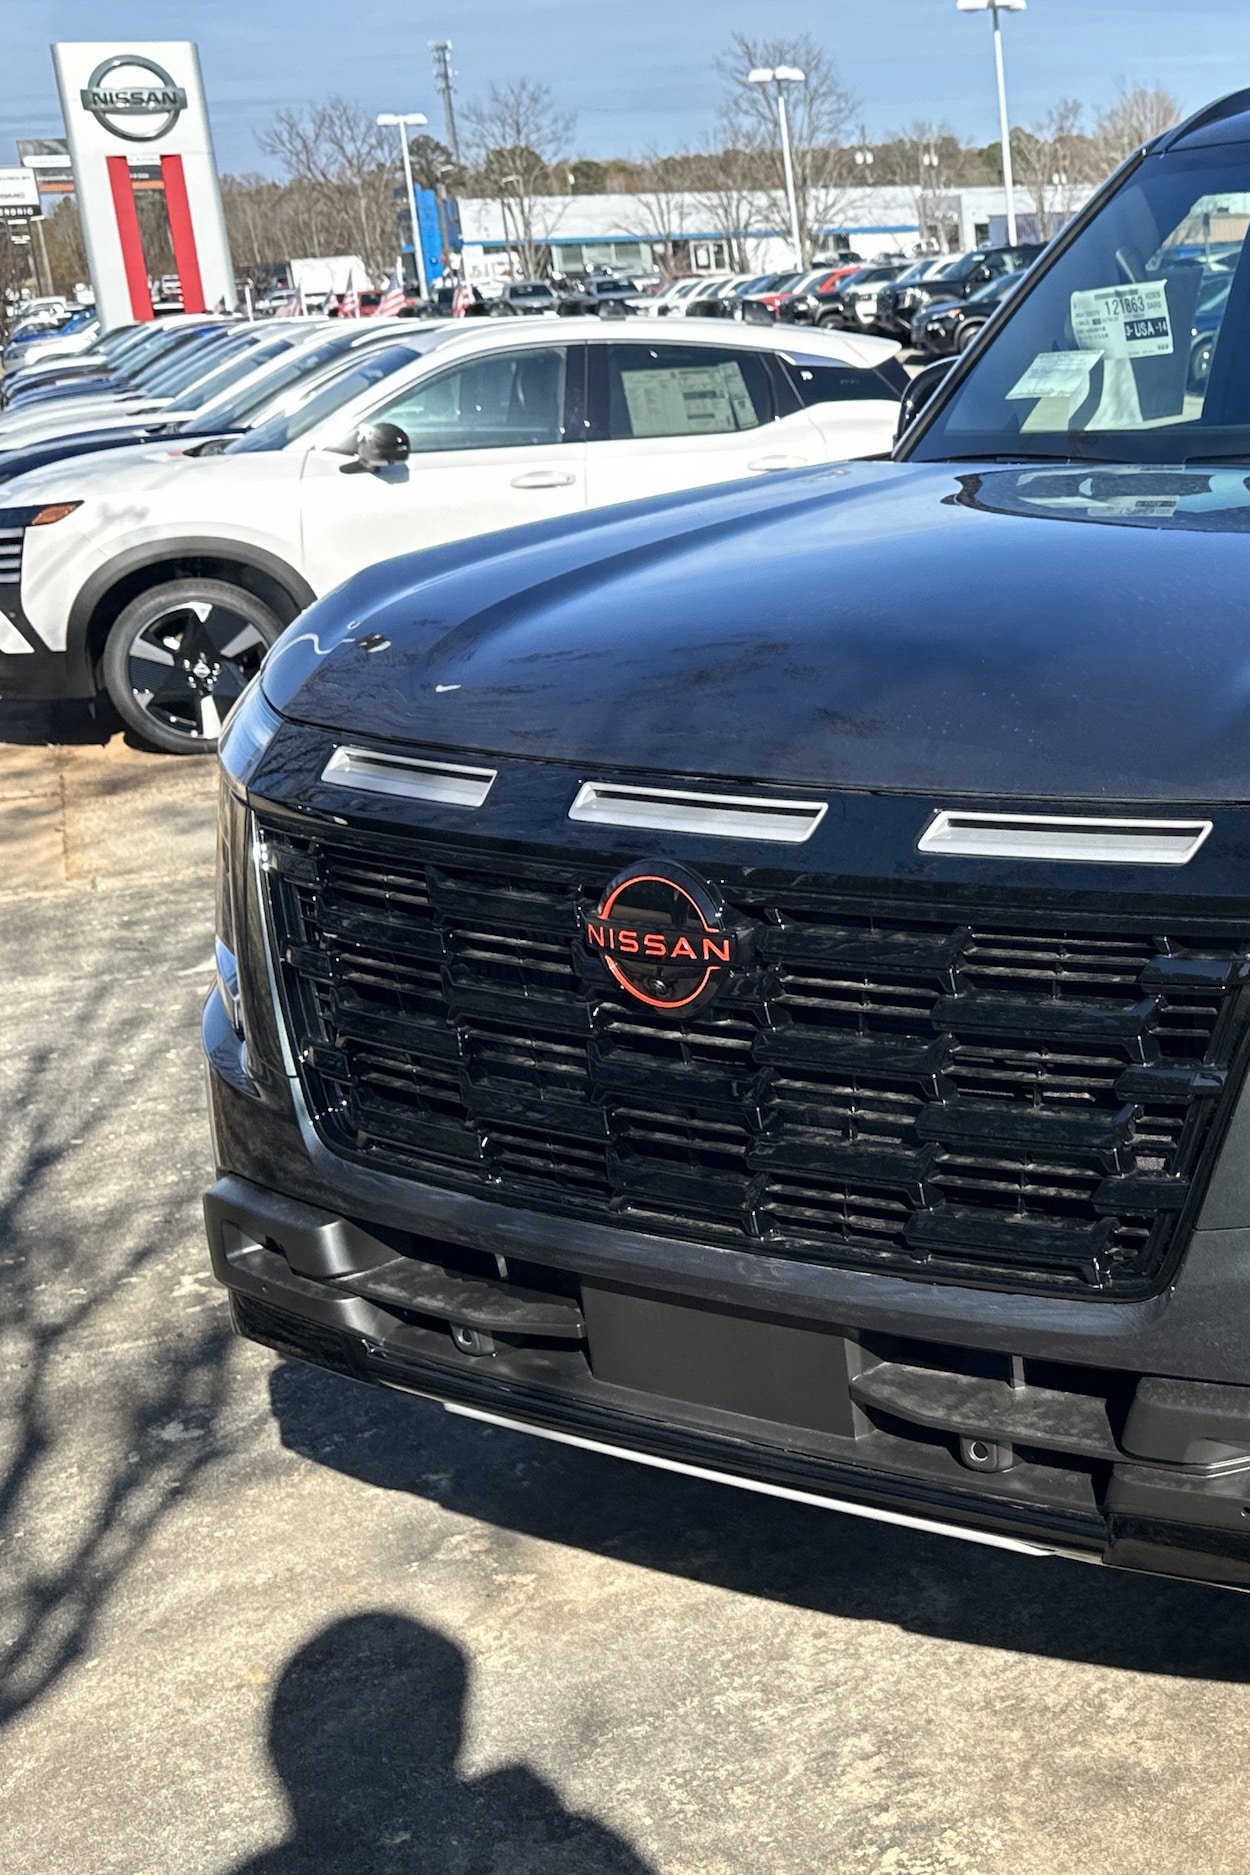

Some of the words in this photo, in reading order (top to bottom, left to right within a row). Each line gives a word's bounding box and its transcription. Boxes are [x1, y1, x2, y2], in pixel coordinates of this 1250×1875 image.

[91, 91, 178, 106] NISSAN
[1104, 296, 1145, 316] 121863
[1134, 320, 1155, 338] USA
[587, 923, 731, 962] NISSAN
